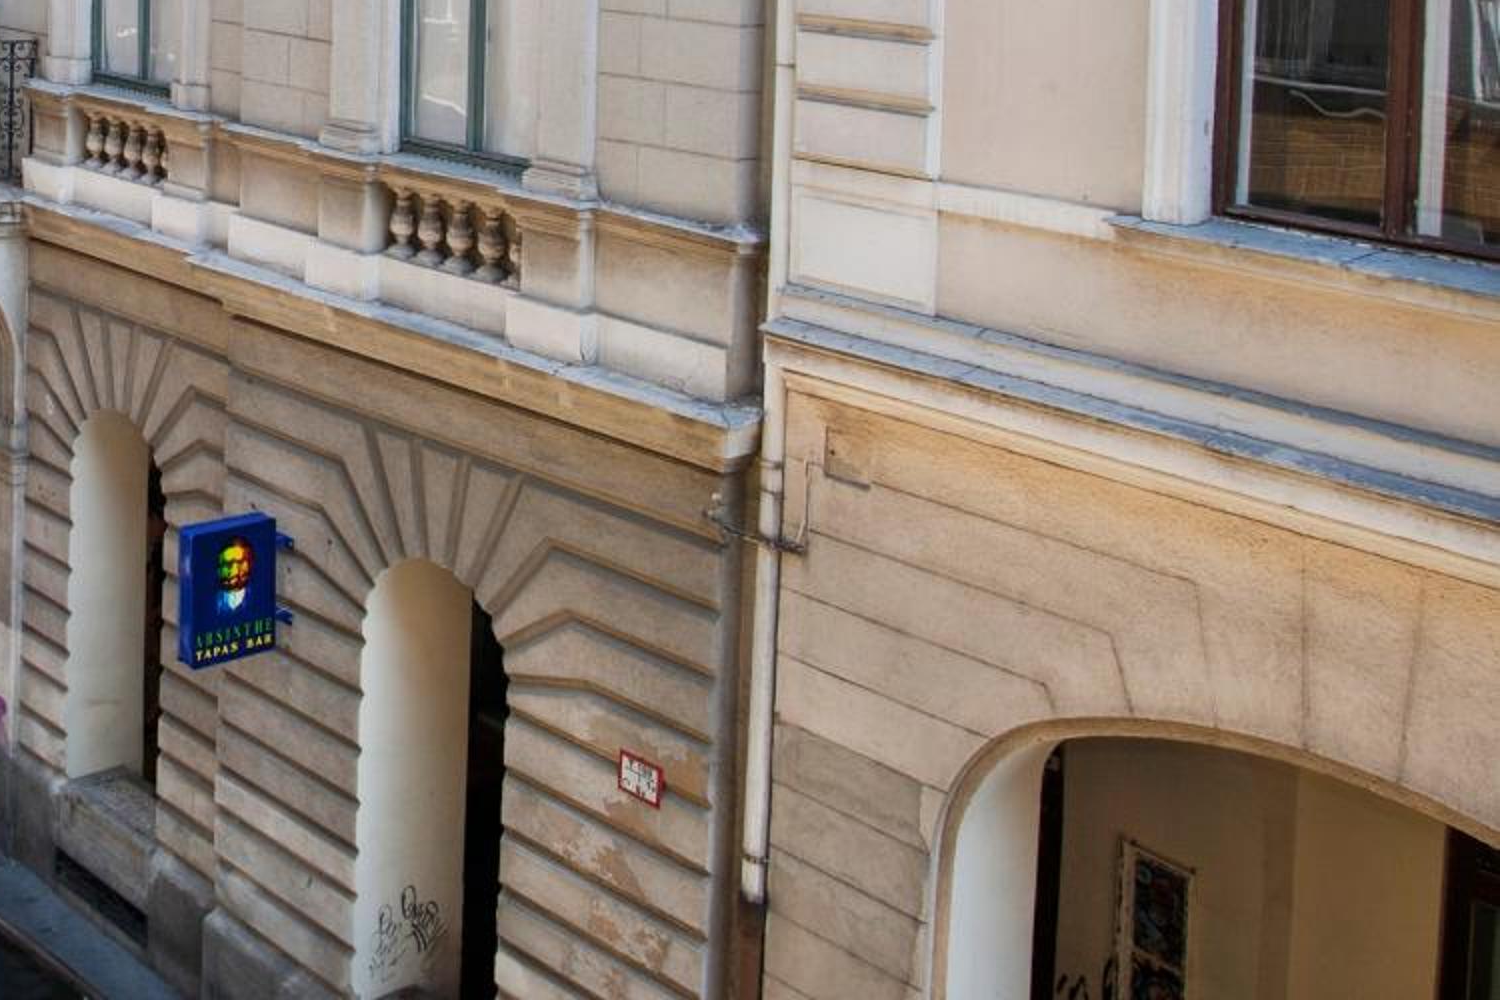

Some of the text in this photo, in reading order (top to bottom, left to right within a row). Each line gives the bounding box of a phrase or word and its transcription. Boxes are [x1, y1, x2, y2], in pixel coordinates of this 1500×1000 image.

[196, 617, 273, 649] ABSINTHE
[196, 633, 272, 662] TAPAS BAR
